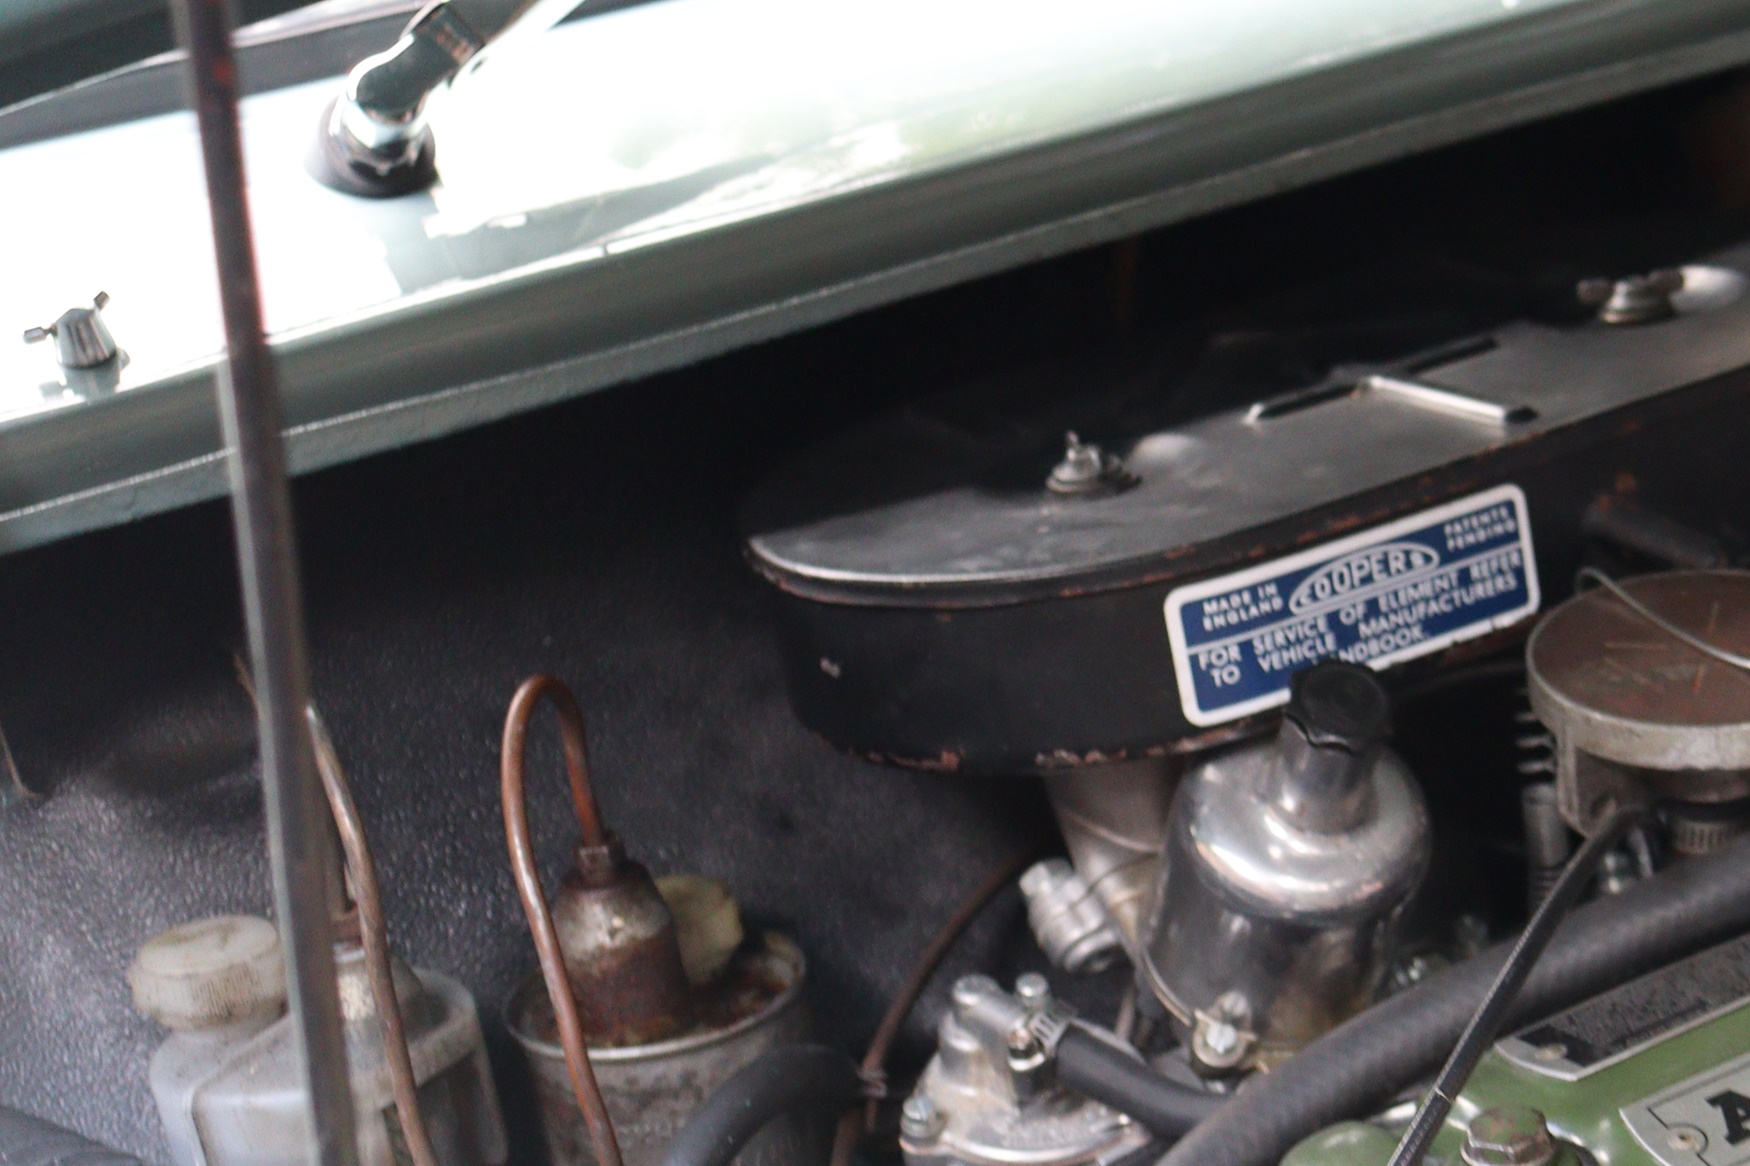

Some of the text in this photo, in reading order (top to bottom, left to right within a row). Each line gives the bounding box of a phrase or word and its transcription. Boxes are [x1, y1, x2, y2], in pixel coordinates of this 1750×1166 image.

[1443, 506, 1510, 536] PATENTS
[1446, 519, 1517, 553] PENDING
[1198, 550, 1521, 671] FOR SERVICE OF ELEMENT REFER
[1202, 581, 1278, 615] MADE IN
[1202, 595, 1283, 632] ENGLAND
[1210, 573, 1517, 687] TO VEHICLE MANUFACTURERS
